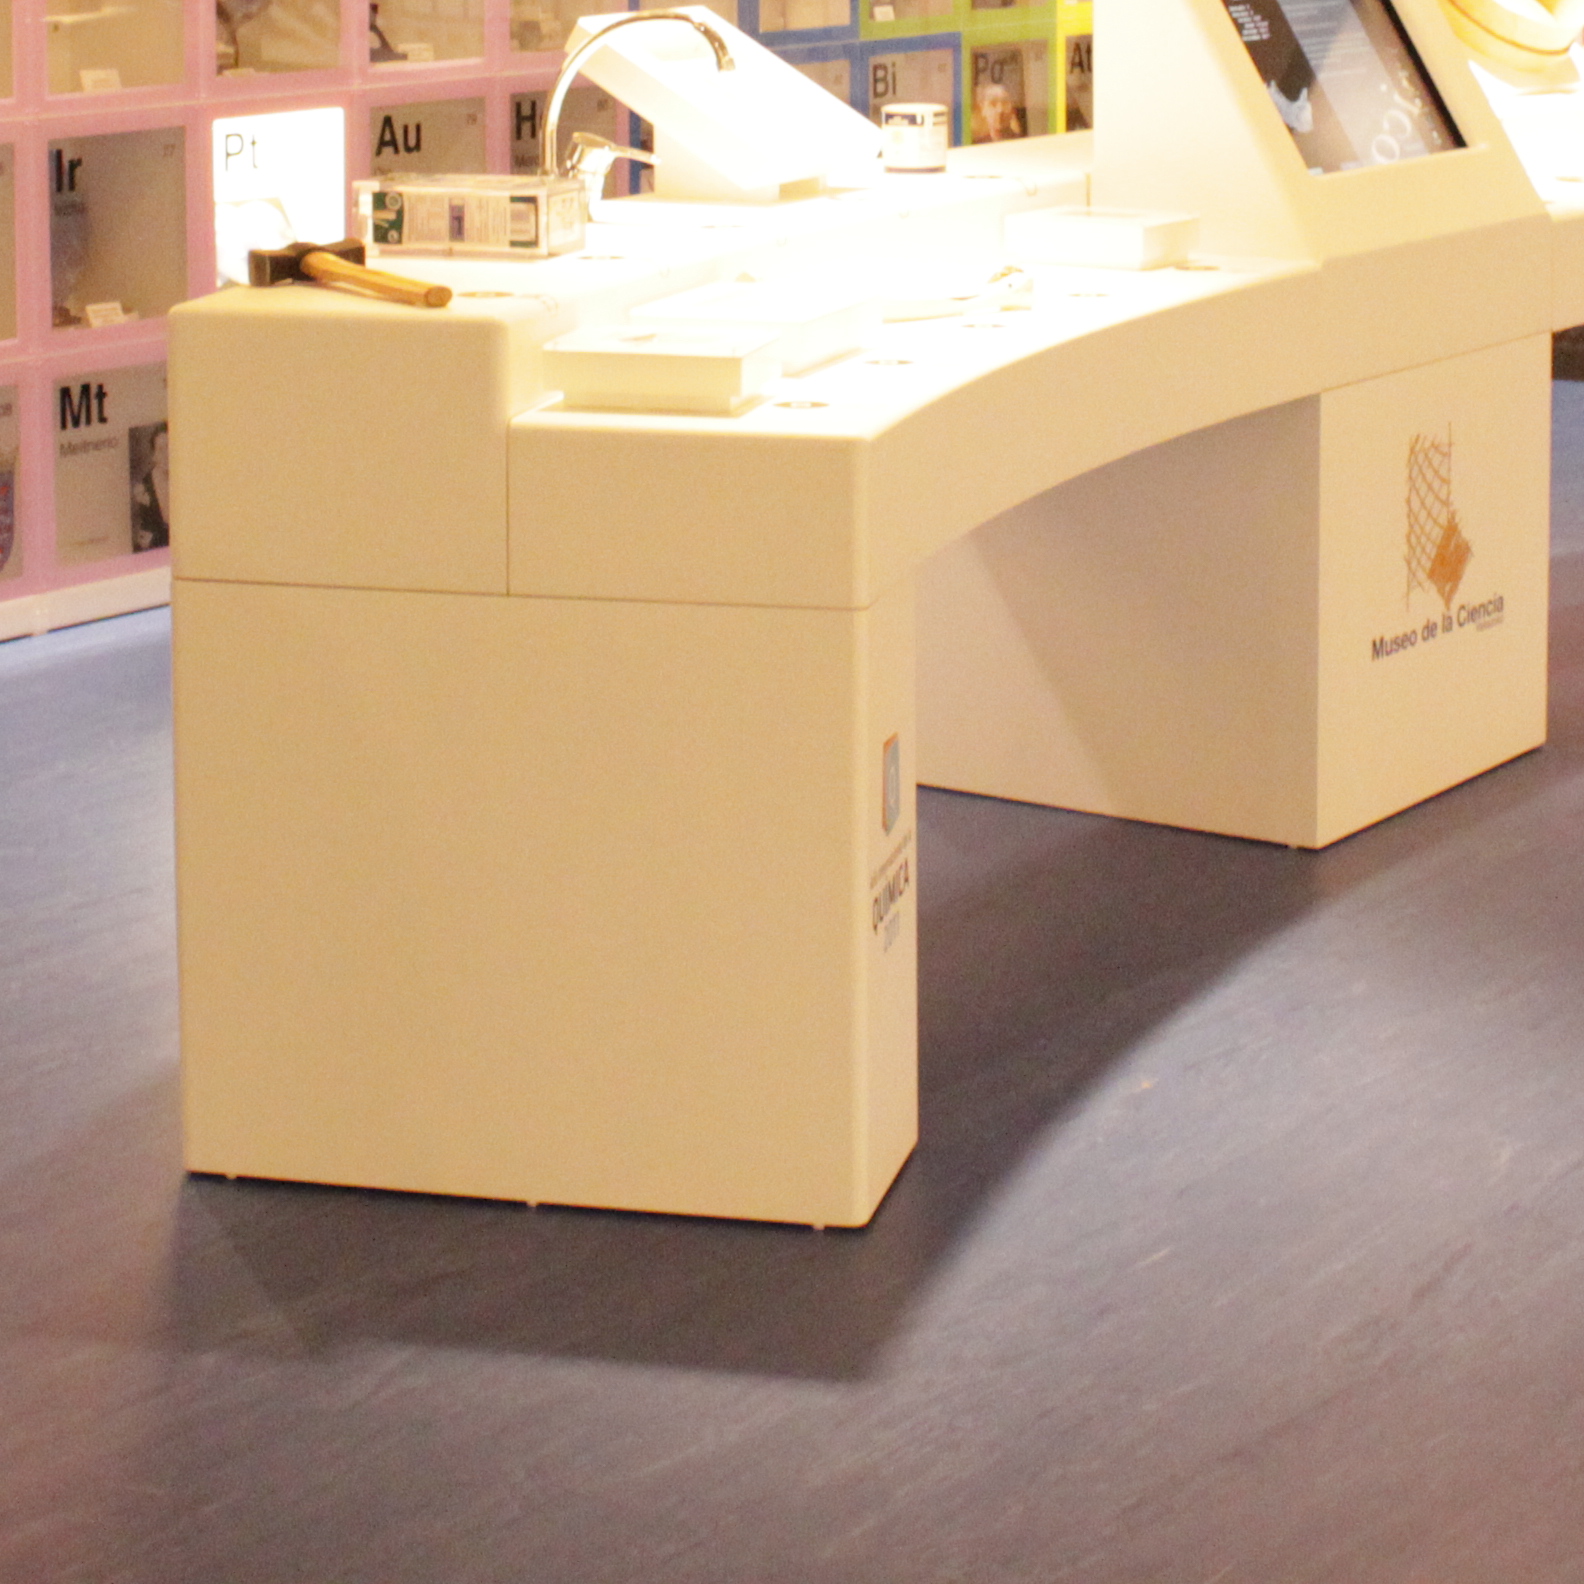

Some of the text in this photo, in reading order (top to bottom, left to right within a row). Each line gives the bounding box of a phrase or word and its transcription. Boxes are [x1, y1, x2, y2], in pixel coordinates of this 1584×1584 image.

[872, 62, 898, 100] Bi
[973, 53, 1005, 86] Po
[223, 133, 258, 172] Pt
[375, 116, 422, 156] Au
[53, 148, 82, 194] Ir
[59, 382, 107, 431] Mt
[1371, 629, 1418, 661] Museo
[1421, 618, 1438, 642] de
[1441, 613, 1453, 633] la
[1457, 593, 1505, 628] Ciencia
